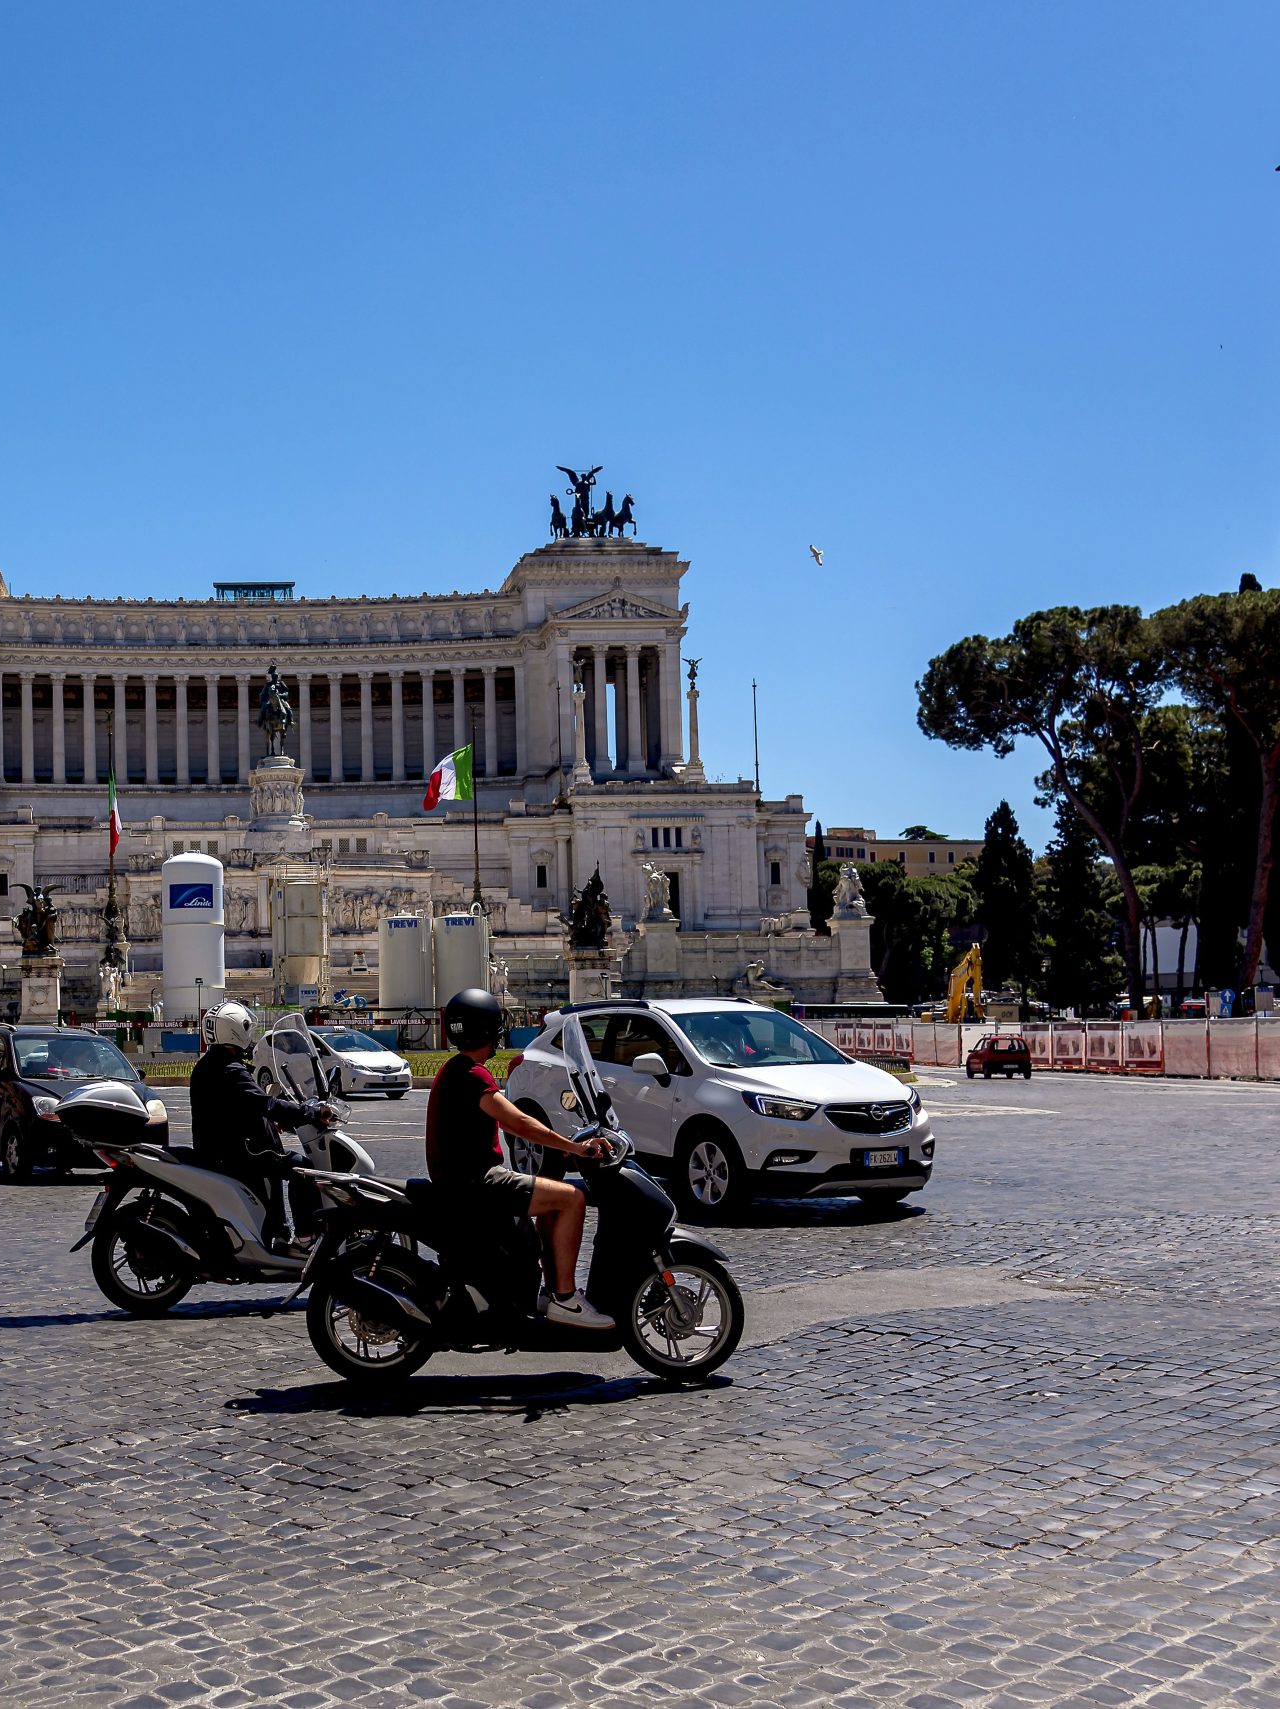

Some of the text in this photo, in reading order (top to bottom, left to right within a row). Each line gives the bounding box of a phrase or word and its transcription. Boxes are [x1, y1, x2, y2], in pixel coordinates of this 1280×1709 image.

[184, 896, 212, 907] Linde
[387, 919, 418, 929] TREVI
[444, 917, 475, 926] TREVI
